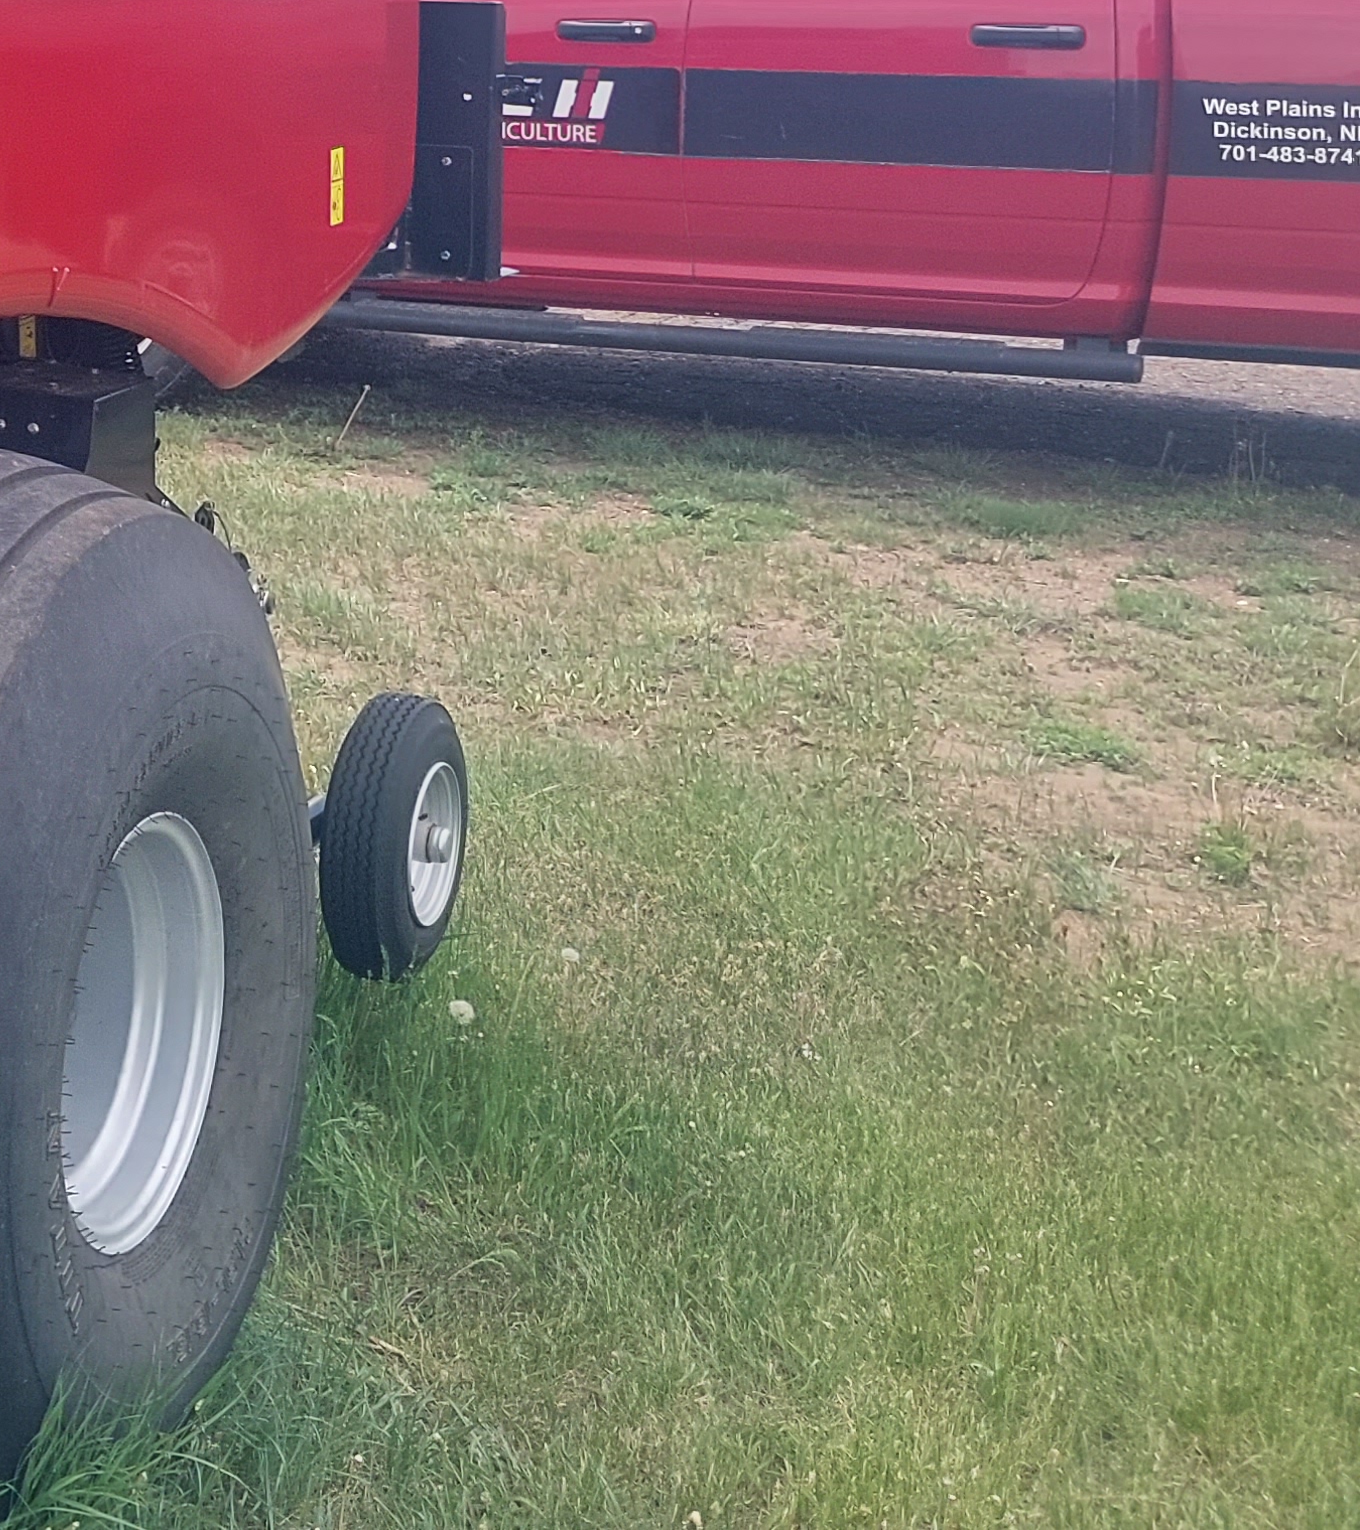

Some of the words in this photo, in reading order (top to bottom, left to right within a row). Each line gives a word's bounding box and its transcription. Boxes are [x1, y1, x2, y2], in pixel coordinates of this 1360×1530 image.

[1202, 97, 1259, 117] West
[1266, 99, 1336, 118] Plains
[1213, 121, 1332, 144] Dickinson,
[1340, 124, 1360, 142] N
